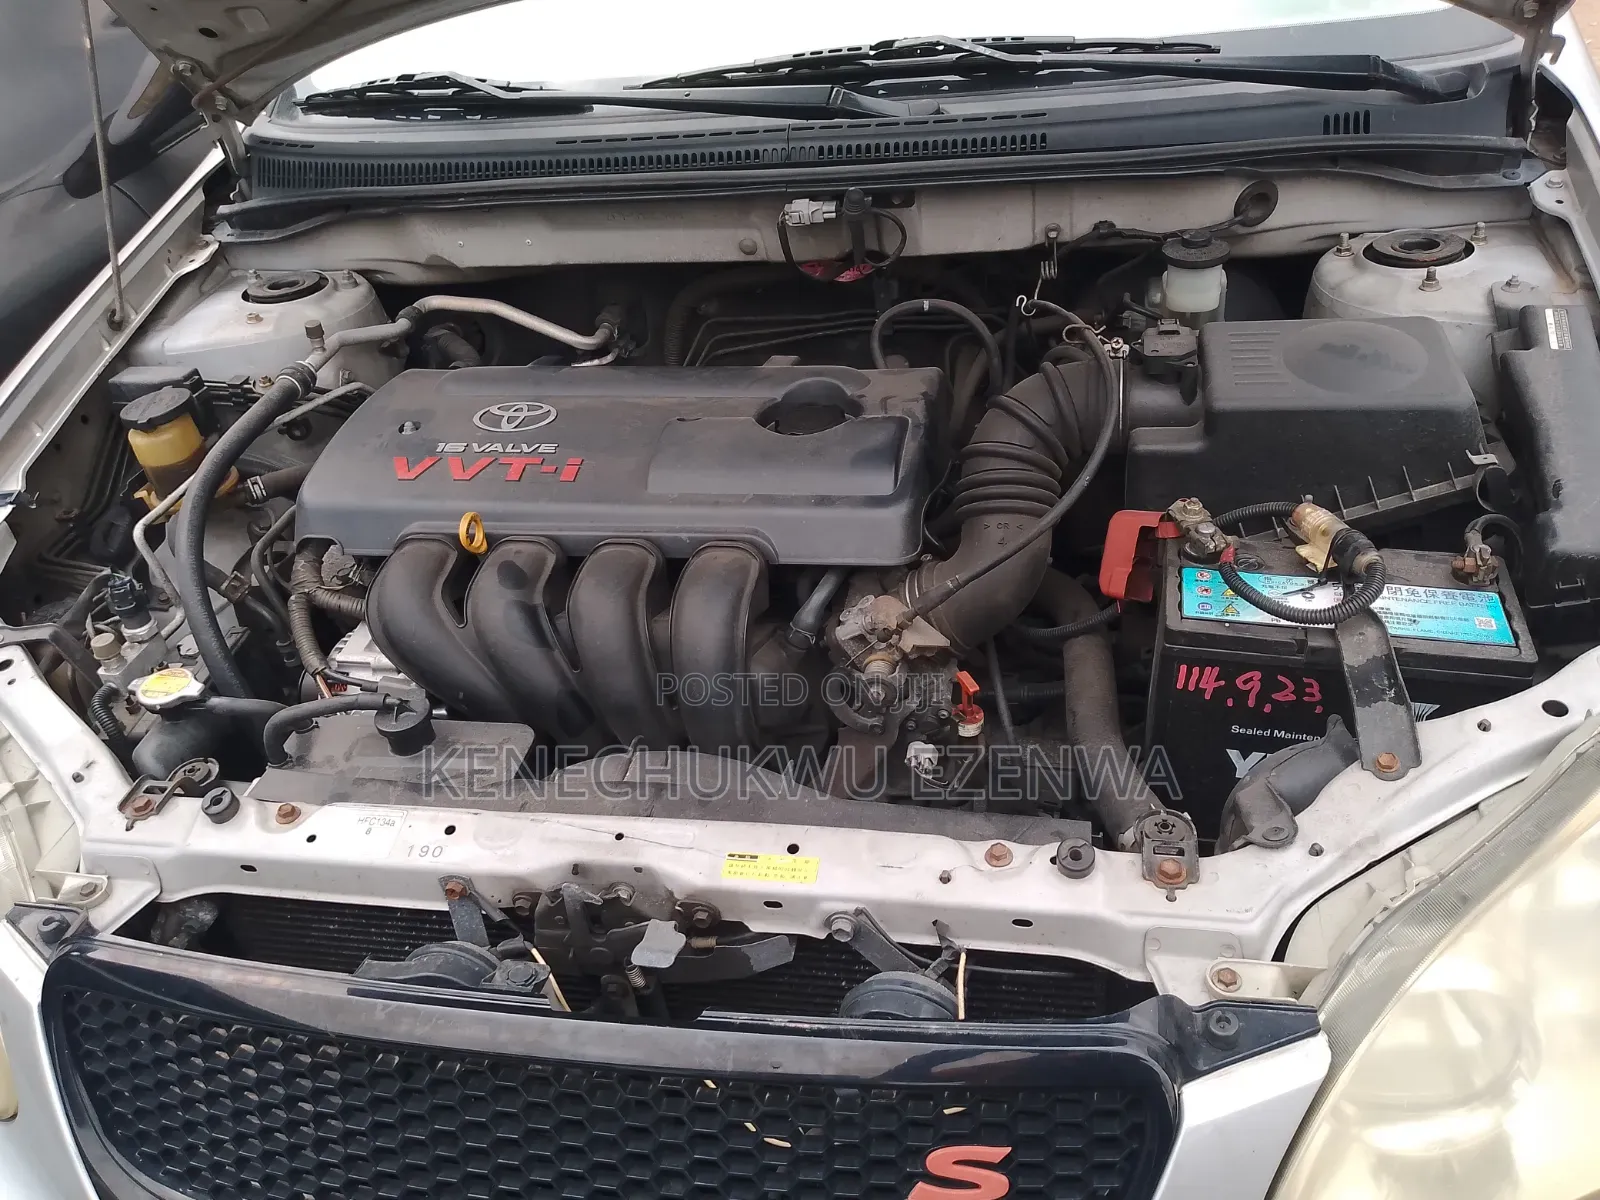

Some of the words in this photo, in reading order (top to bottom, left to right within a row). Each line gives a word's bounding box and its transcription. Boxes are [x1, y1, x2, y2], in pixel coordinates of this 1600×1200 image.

[436, 442, 468, 454] 16
[472, 443, 558, 454] VALVE
[393, 456, 584, 482] VVT-i
[1231, 725, 1270, 737] Sealed
[407, 844, 444, 858] 190
[907, 1145, 1012, 1200] S
